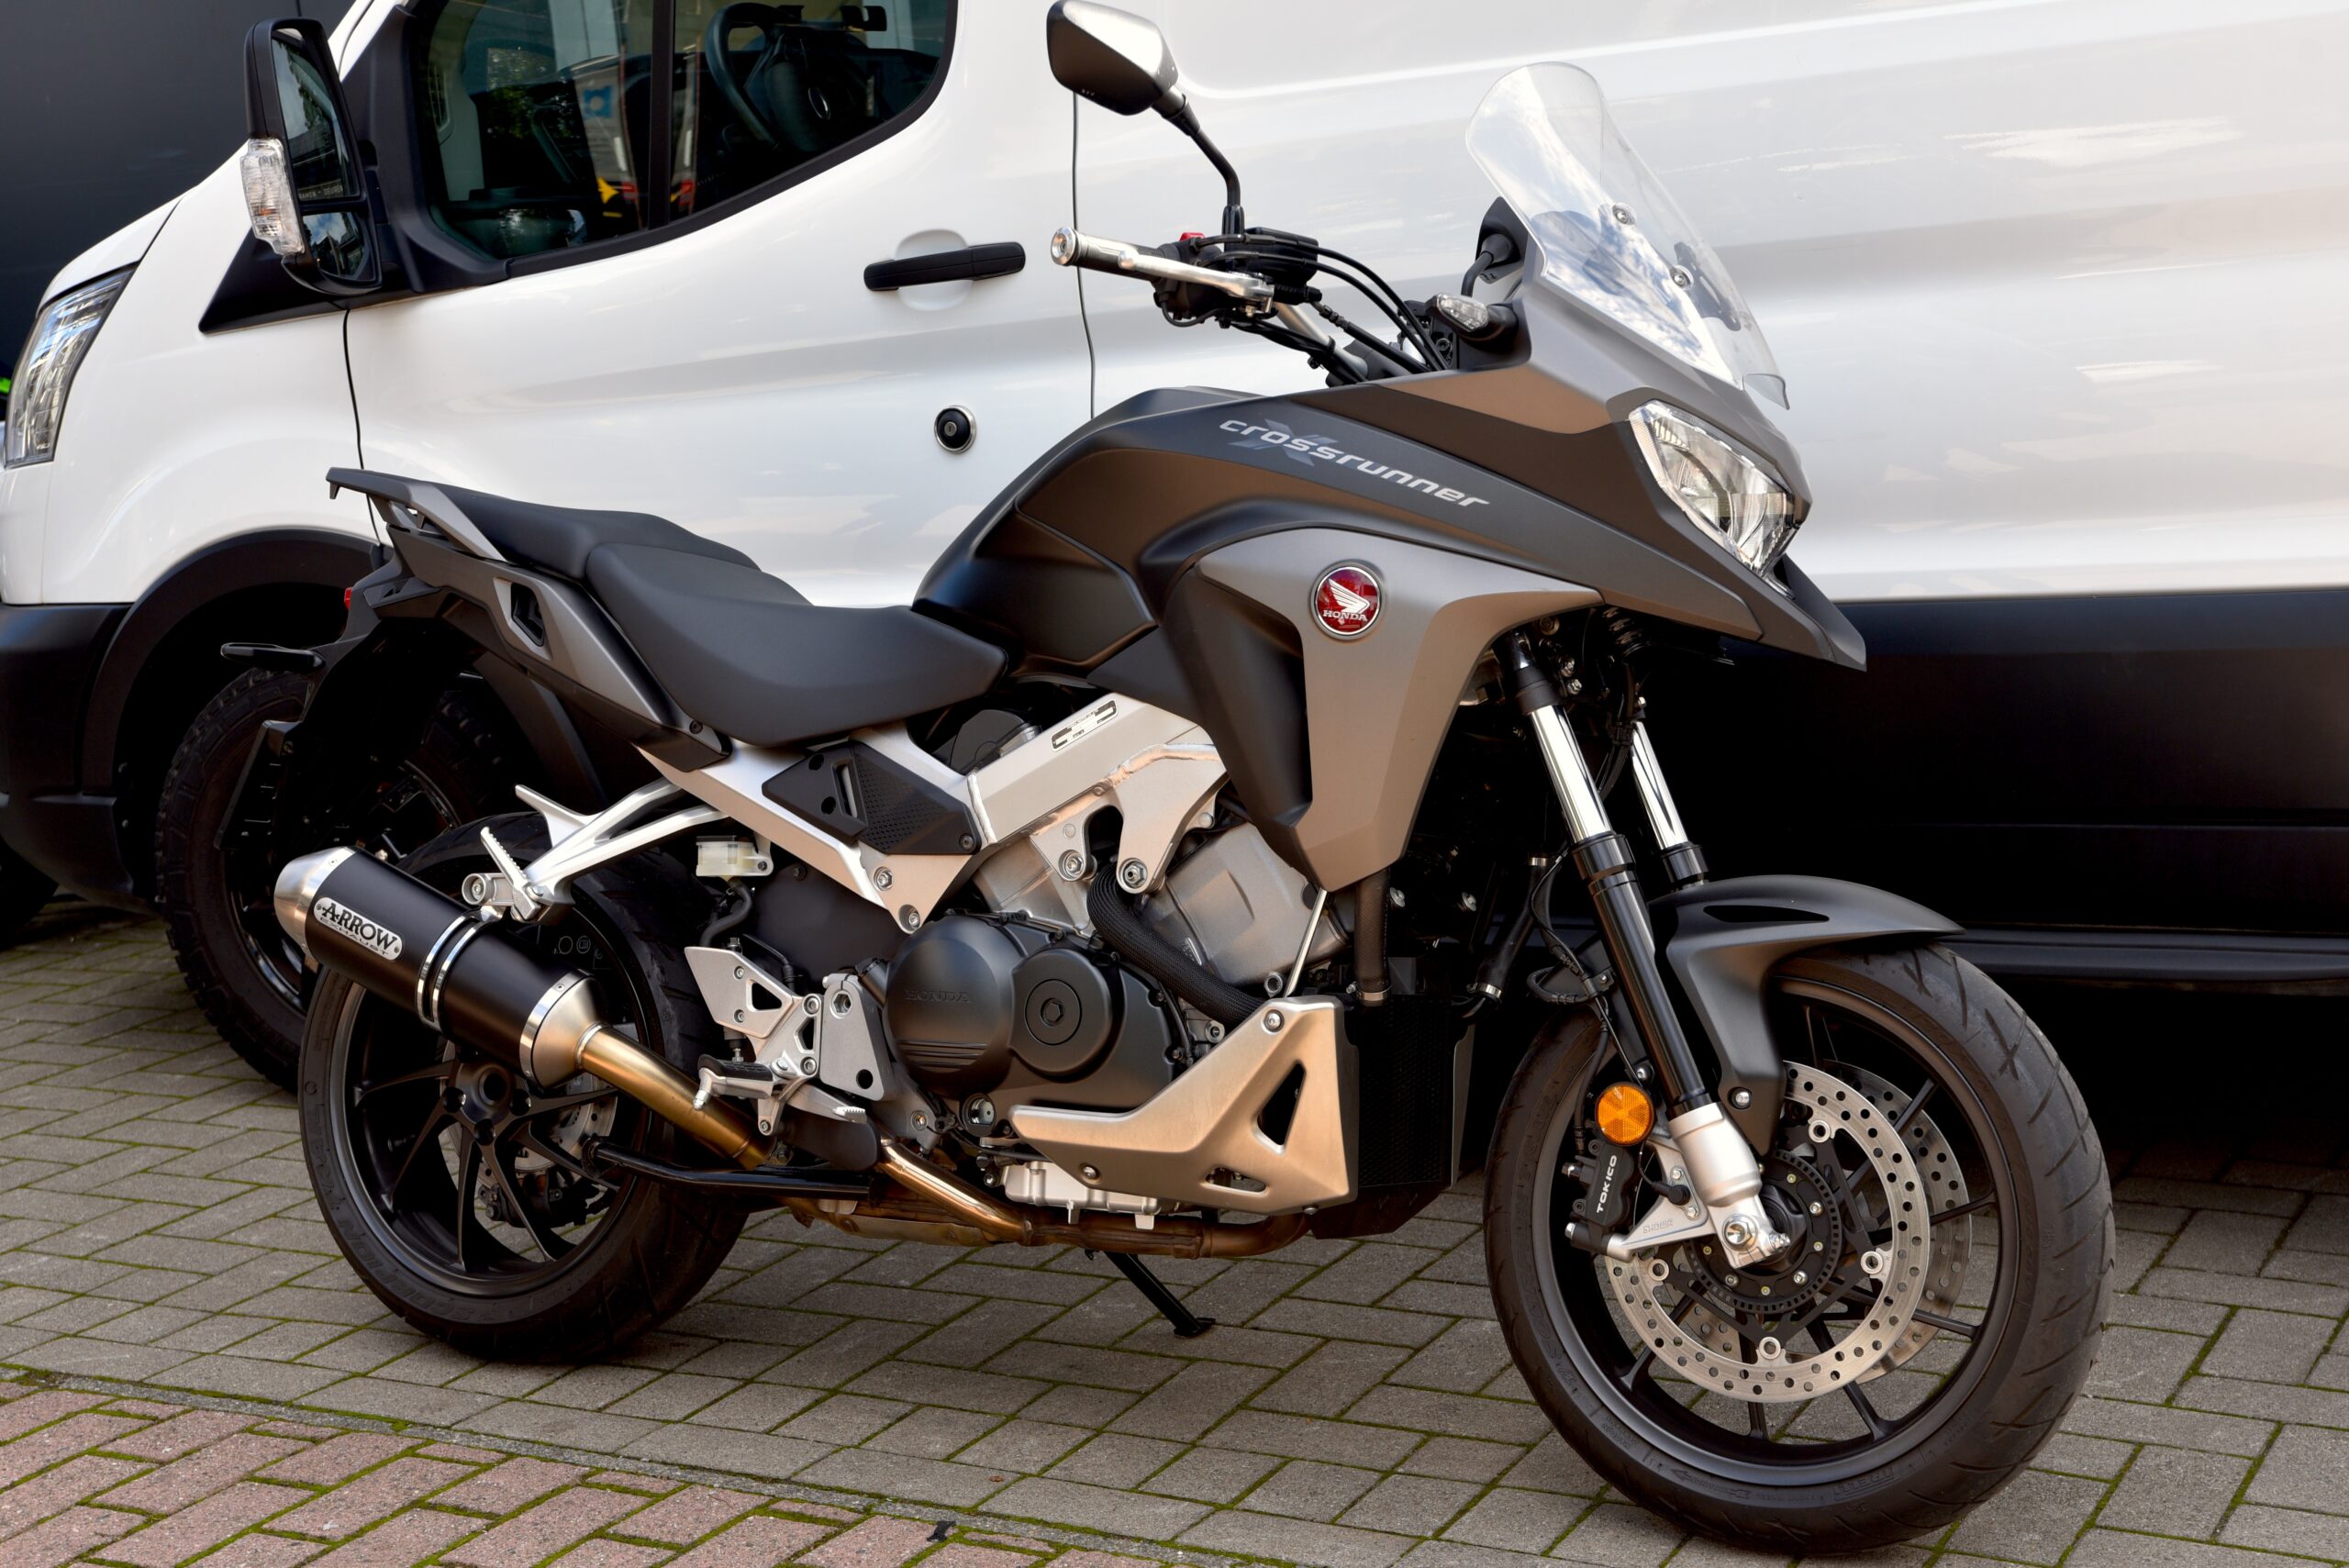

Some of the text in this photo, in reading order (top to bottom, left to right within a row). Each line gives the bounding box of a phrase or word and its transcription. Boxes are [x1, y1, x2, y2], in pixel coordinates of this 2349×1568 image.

[1219, 419, 1490, 506] crossrunner
[1322, 609, 1368, 622] HONDA
[319, 917, 389, 955] EXHAUST
[321, 902, 398, 951] ARROW
[903, 990, 972, 1004] HONDA
[1597, 1154, 1618, 1213] TOKICO
[1642, 1218, 1674, 1234] SHOWA
